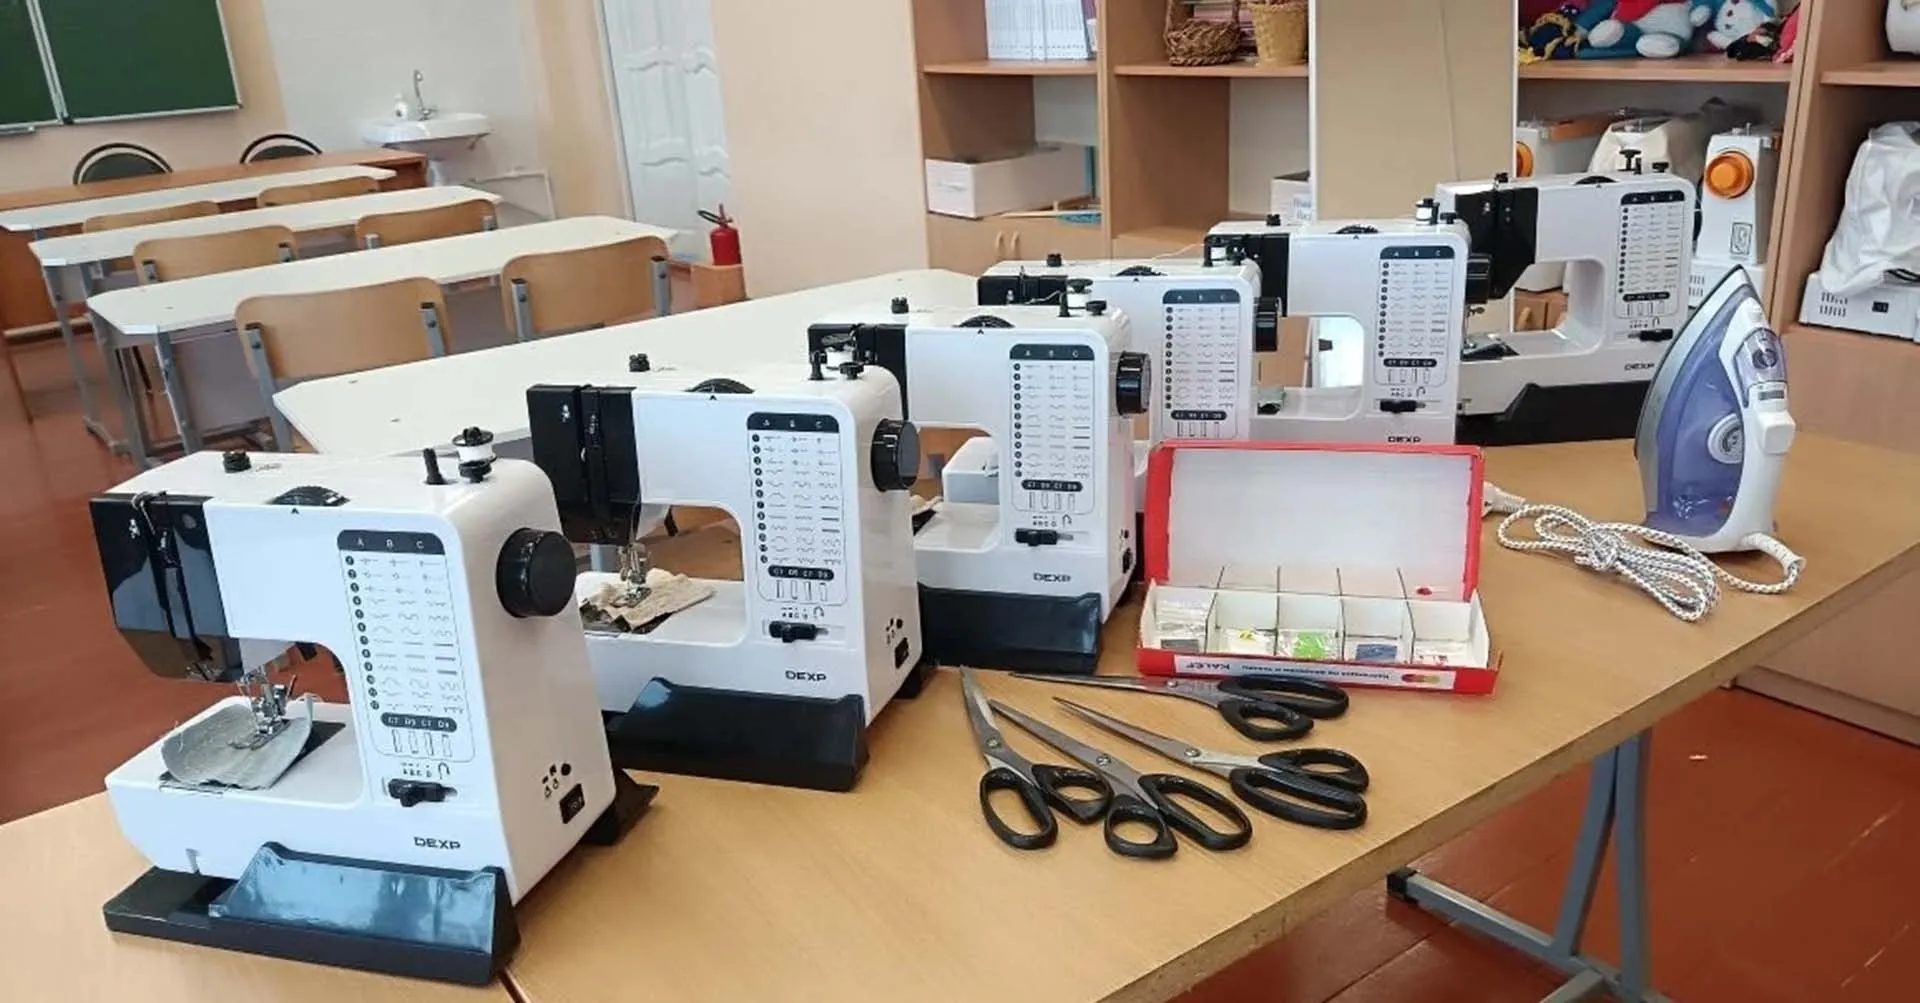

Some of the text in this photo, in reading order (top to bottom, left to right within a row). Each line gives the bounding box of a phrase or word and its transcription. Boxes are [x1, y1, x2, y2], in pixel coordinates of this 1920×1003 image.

[416, 540, 424, 549] C
[785, 670, 827, 682] DEXP
[414, 836, 461, 850] DEXP
